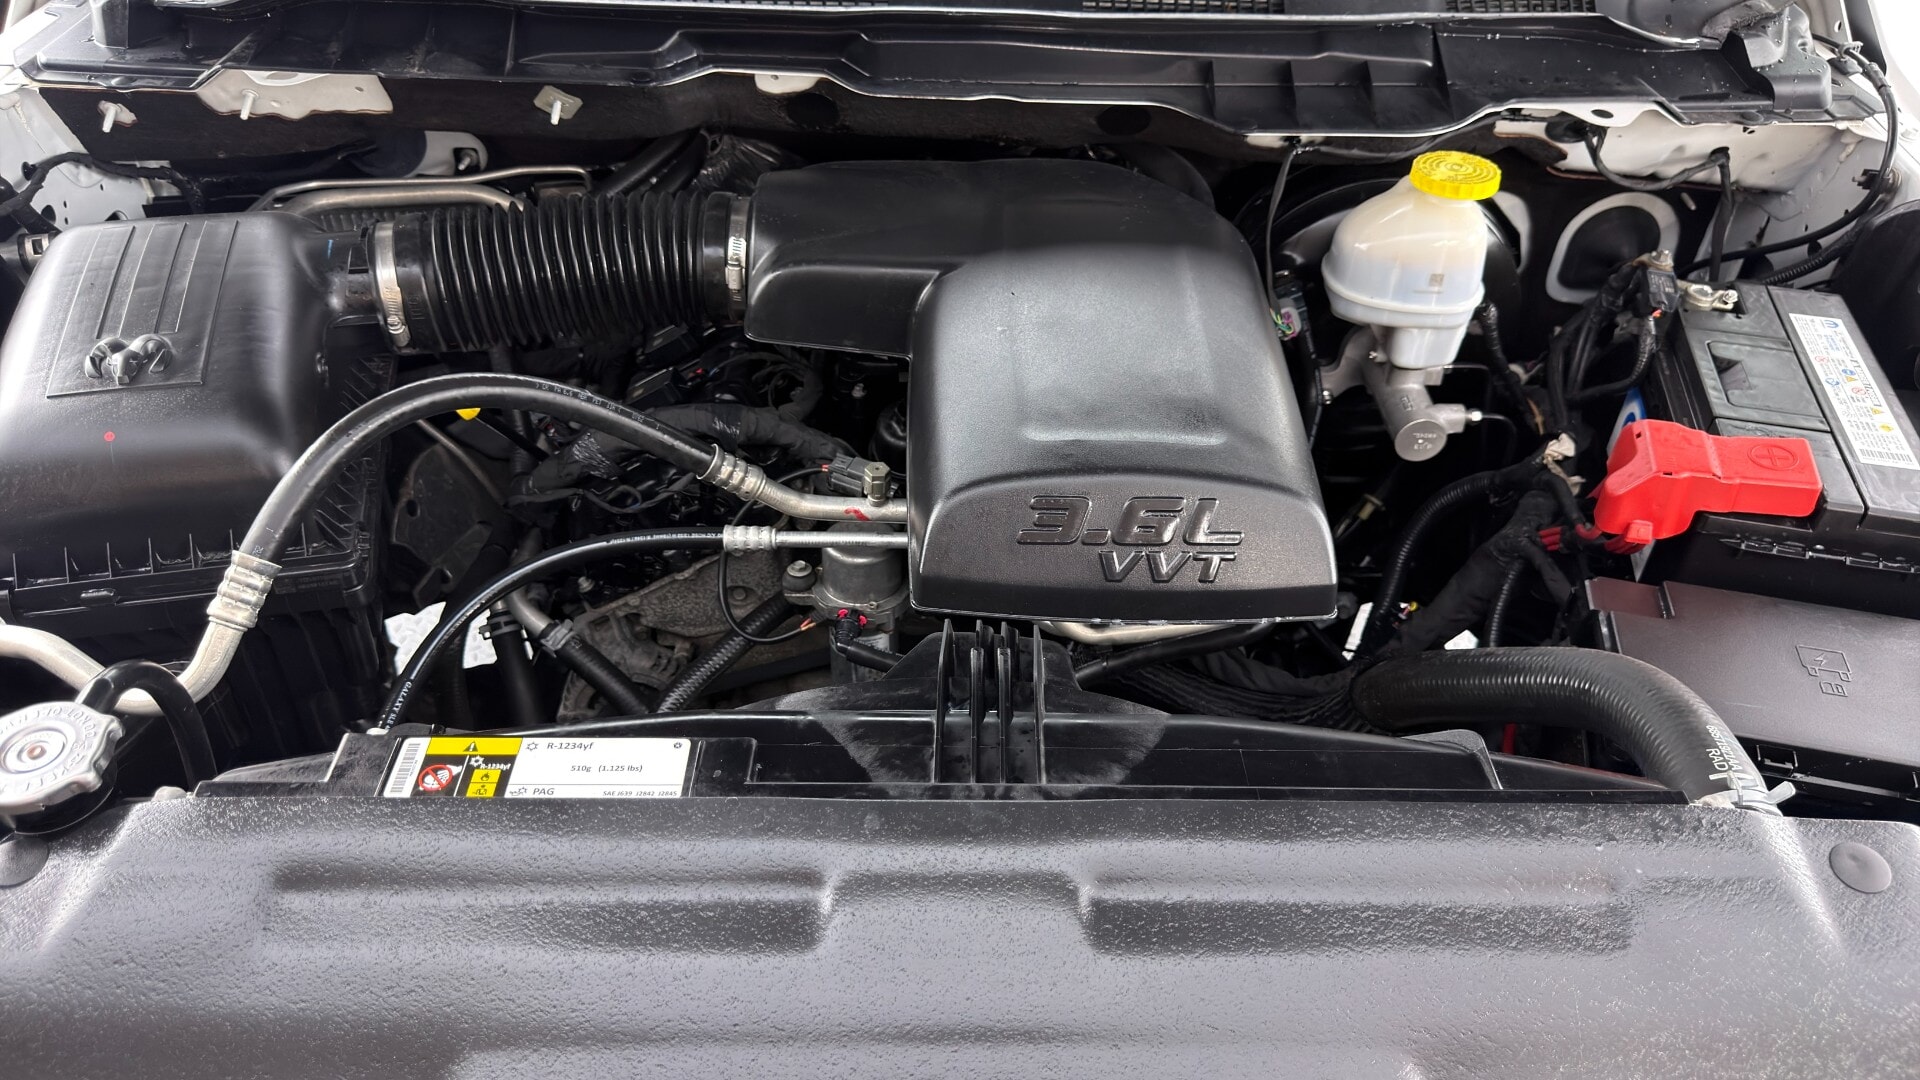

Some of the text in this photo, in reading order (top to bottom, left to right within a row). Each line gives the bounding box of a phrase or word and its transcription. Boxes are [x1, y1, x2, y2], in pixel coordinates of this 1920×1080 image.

[1016, 495, 1244, 546] 3.6L
[1099, 550, 1237, 583] VVT
[393, 681, 412, 713] GALAXY
[547, 742, 594, 750] R-1234yf
[570, 765, 591, 773] 510g
[1706, 748, 1729, 770] RAD
[532, 788, 555, 796] PAG
